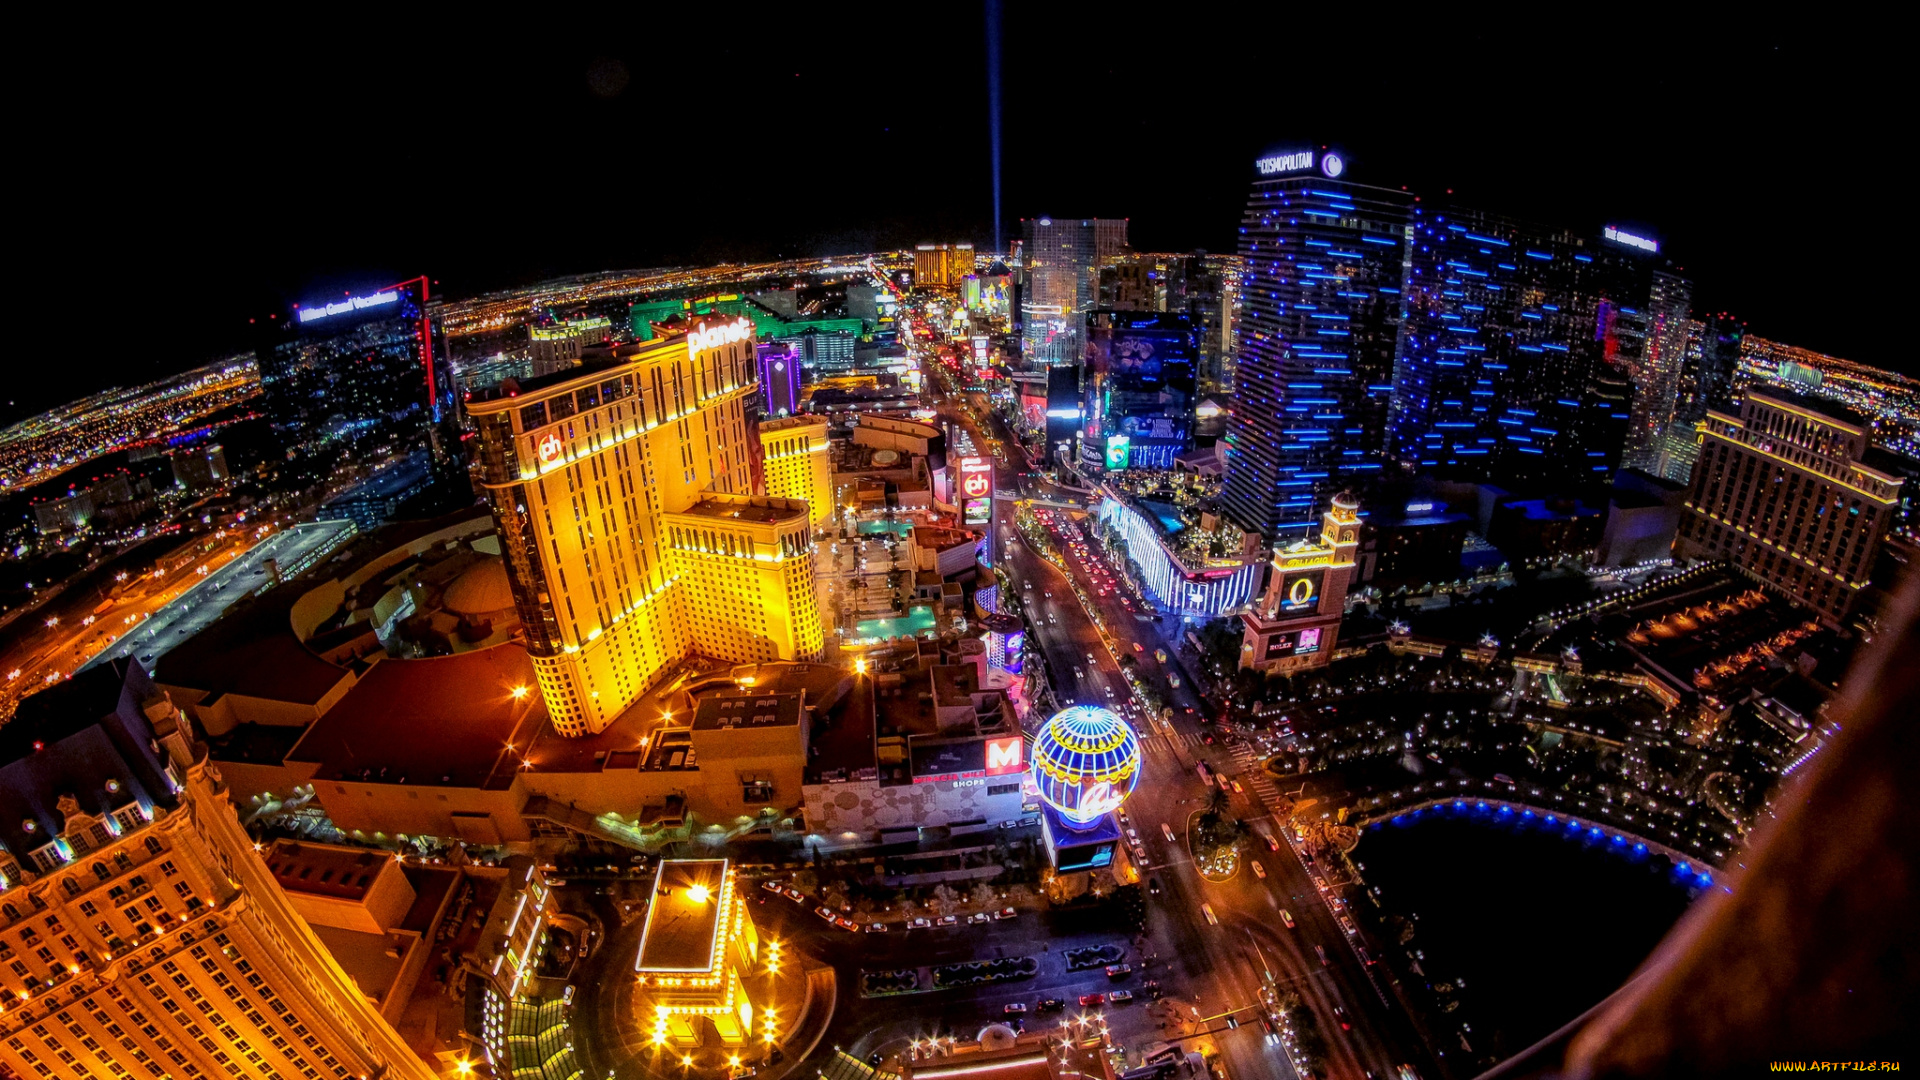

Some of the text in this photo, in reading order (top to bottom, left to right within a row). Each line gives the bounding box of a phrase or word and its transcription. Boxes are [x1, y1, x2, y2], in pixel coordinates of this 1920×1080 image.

[1261, 152, 1313, 174] COSMOPOLITAN
[687, 317, 750, 361] planet
[967, 474, 989, 494] ph
[1269, 642, 1293, 651] ROLEX
[988, 740, 1020, 769] M
[912, 770, 985, 784] MIRACLE MILE
[952, 779, 985, 788] SHOPS
